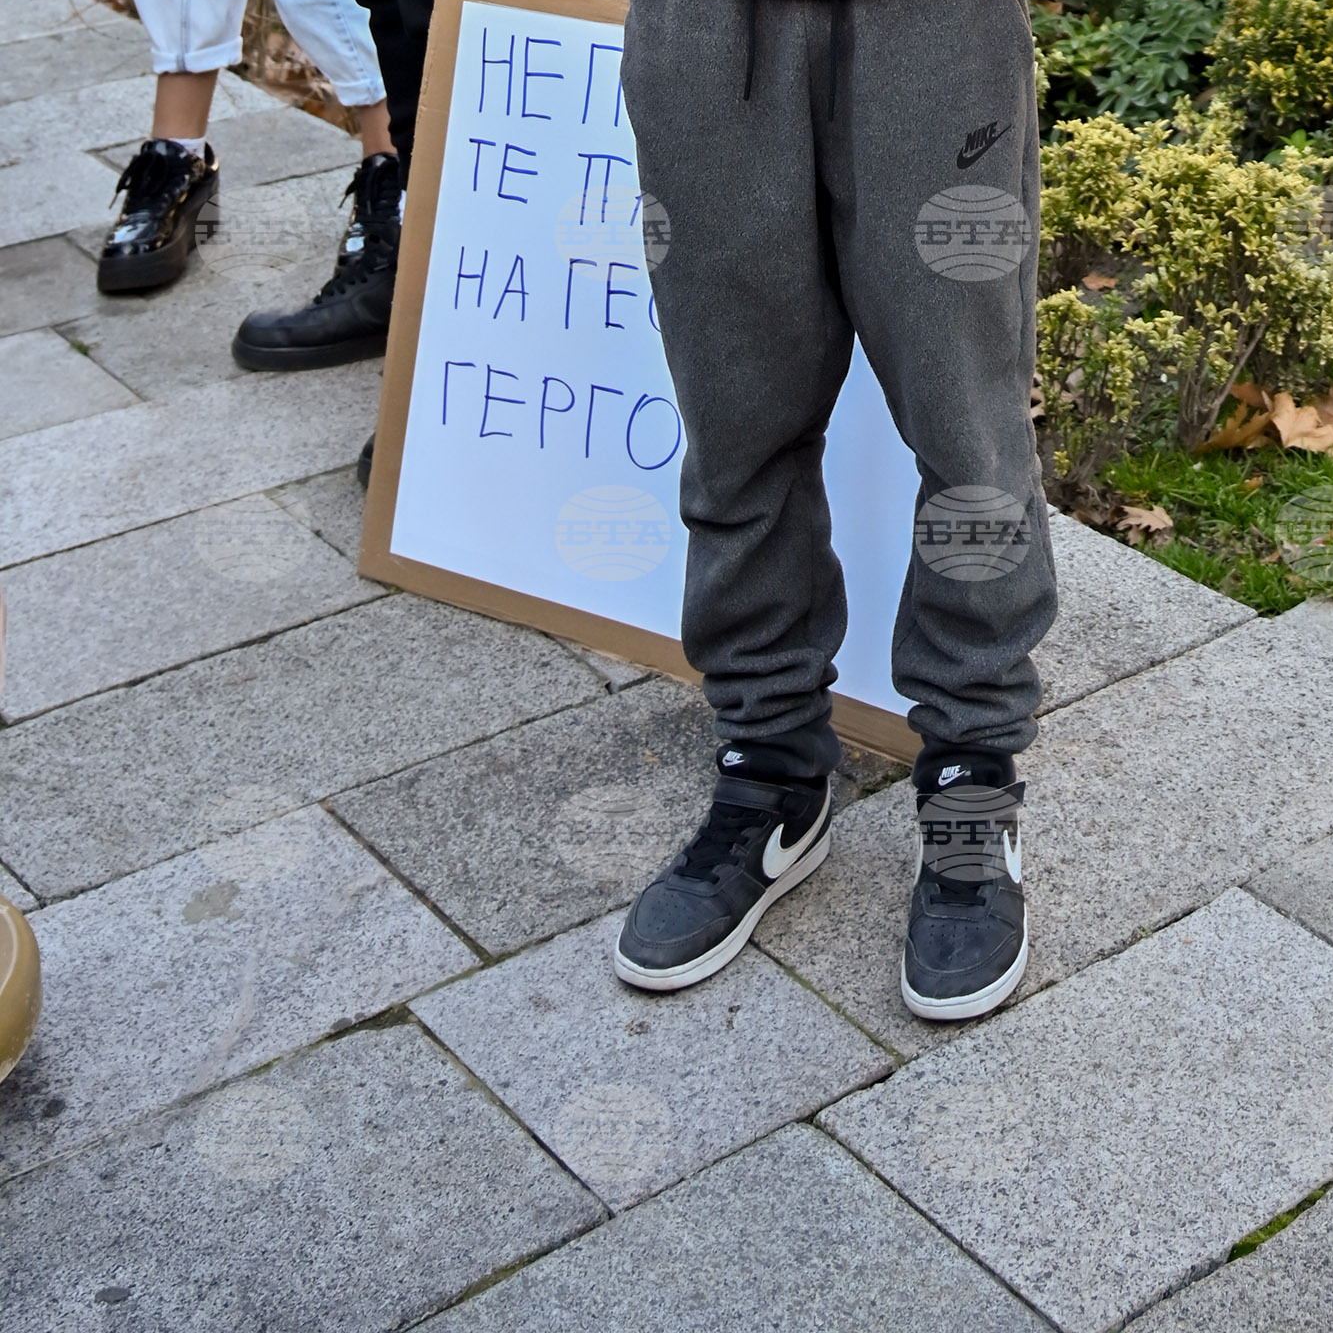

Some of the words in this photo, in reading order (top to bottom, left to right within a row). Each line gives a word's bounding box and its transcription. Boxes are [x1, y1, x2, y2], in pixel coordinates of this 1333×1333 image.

[478, 27, 565, 120] НЕ
[469, 138, 539, 204] ТЕ
[455, 246, 530, 321] НА
[941, 764, 961, 779] NIKE
